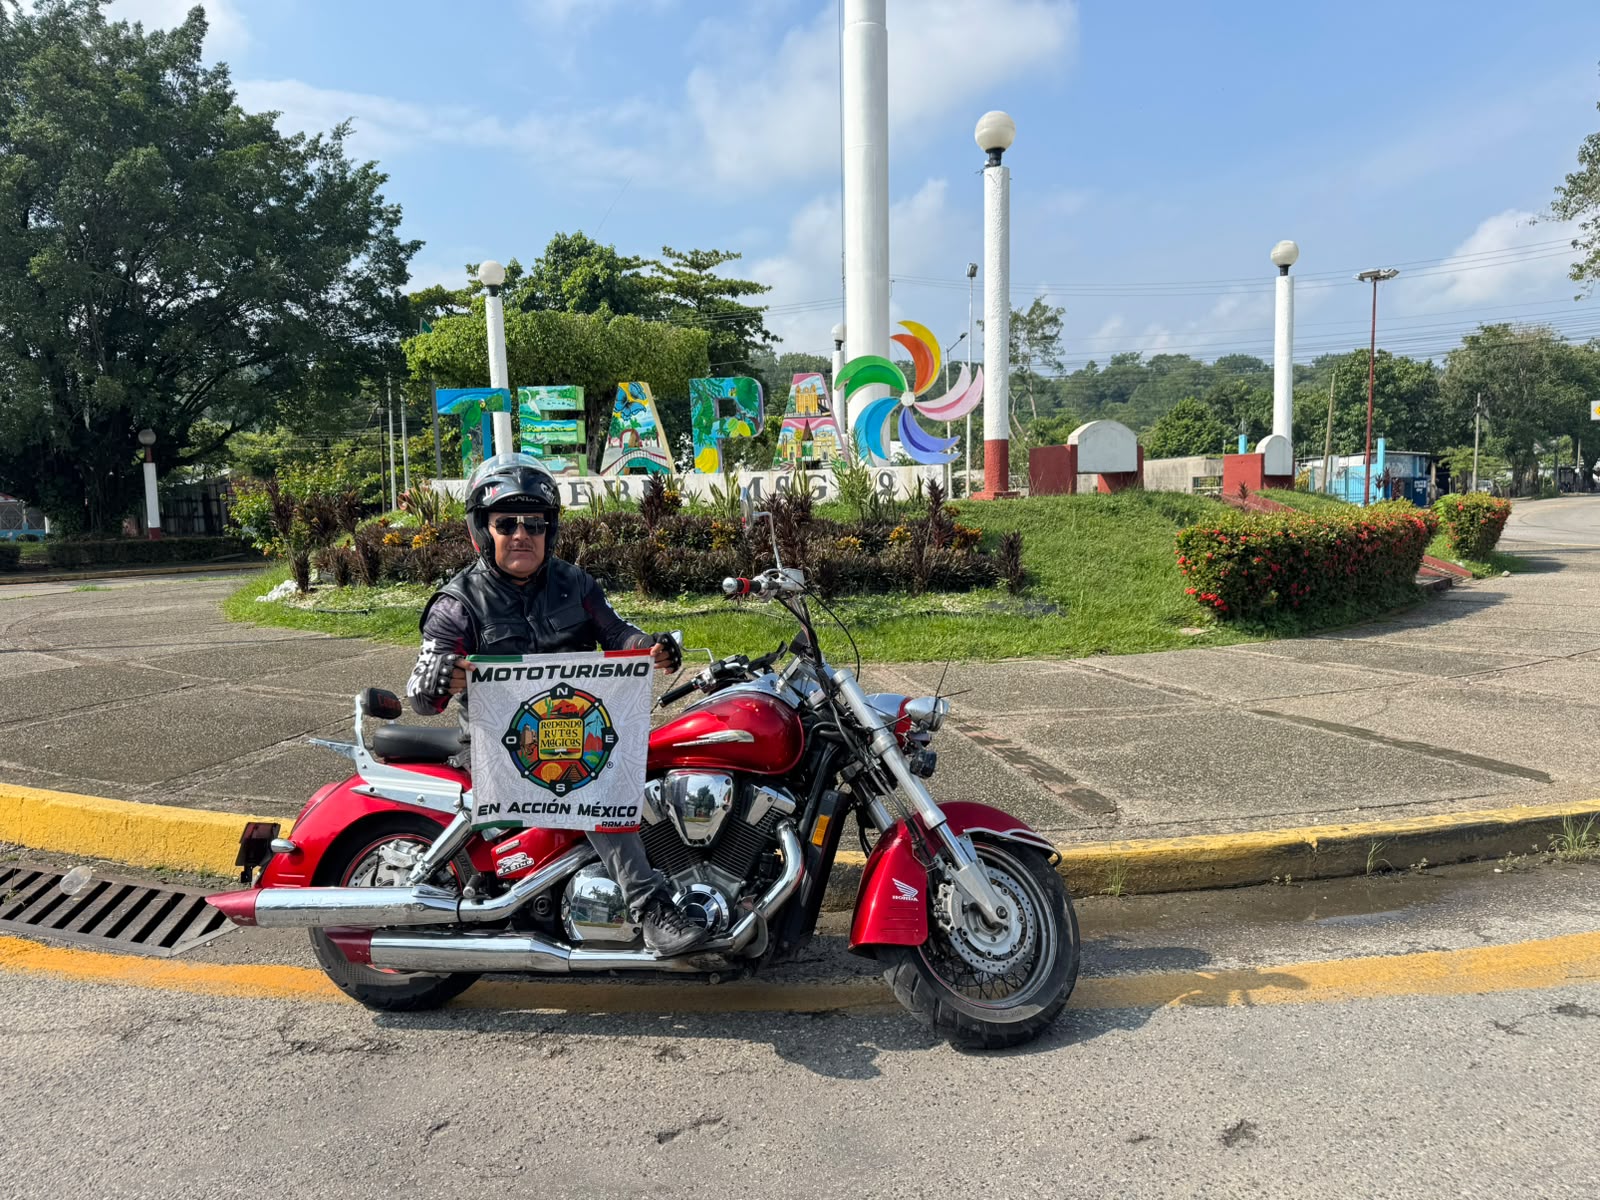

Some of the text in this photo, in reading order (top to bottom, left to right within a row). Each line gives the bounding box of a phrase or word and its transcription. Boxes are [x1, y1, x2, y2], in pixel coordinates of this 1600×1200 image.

[436, 373, 851, 478] TEAPA
[471, 662, 650, 683] MOTOTURISMO
[556, 687, 569, 696] N
[605, 734, 615, 743] E
[555, 781, 566, 792] S
[477, 798, 638, 817] EN ACCIÓN MÉXICO
[891, 894, 919, 902] HONDA
